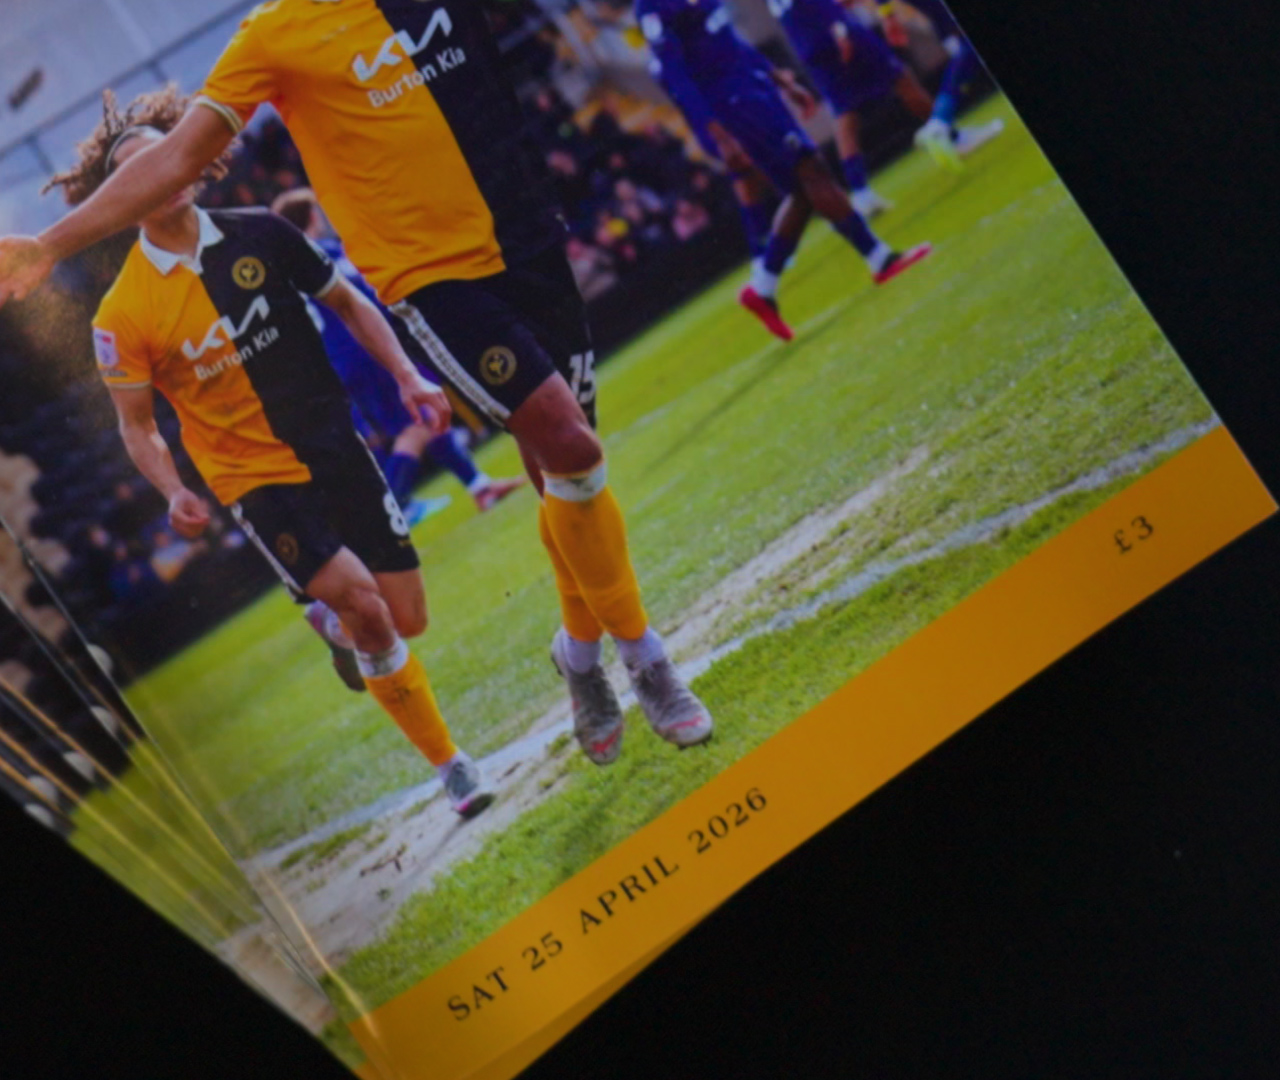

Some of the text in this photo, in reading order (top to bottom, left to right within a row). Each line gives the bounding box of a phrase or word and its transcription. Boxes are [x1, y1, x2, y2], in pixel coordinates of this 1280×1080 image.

[366, 47, 466, 109] Burton Kia
[193, 325, 280, 382] Burton Kia
[1113, 515, 1154, 556] £3
[446, 787, 768, 1021] SAT 25 APRIL 2026
